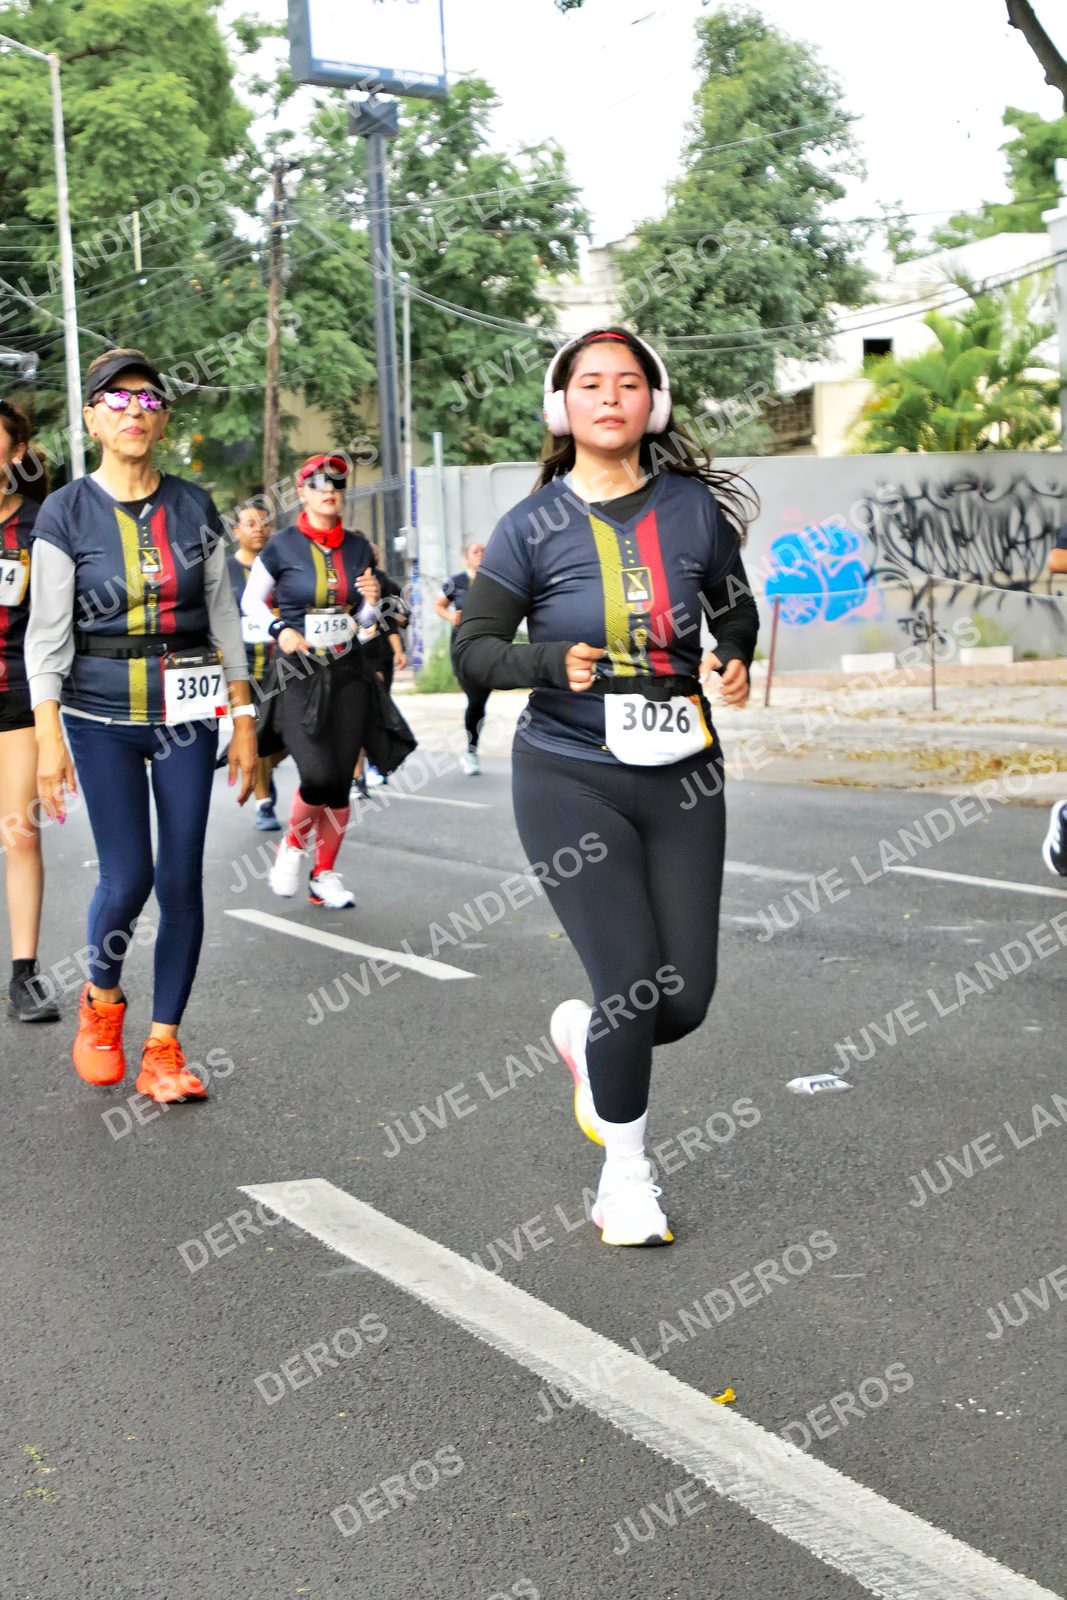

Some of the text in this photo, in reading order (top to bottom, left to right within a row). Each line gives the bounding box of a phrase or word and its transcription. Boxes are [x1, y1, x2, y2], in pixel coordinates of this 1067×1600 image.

[314, 618, 349, 634] 2158
[177, 674, 221, 701] 3307
[622, 701, 691, 734] 3026
